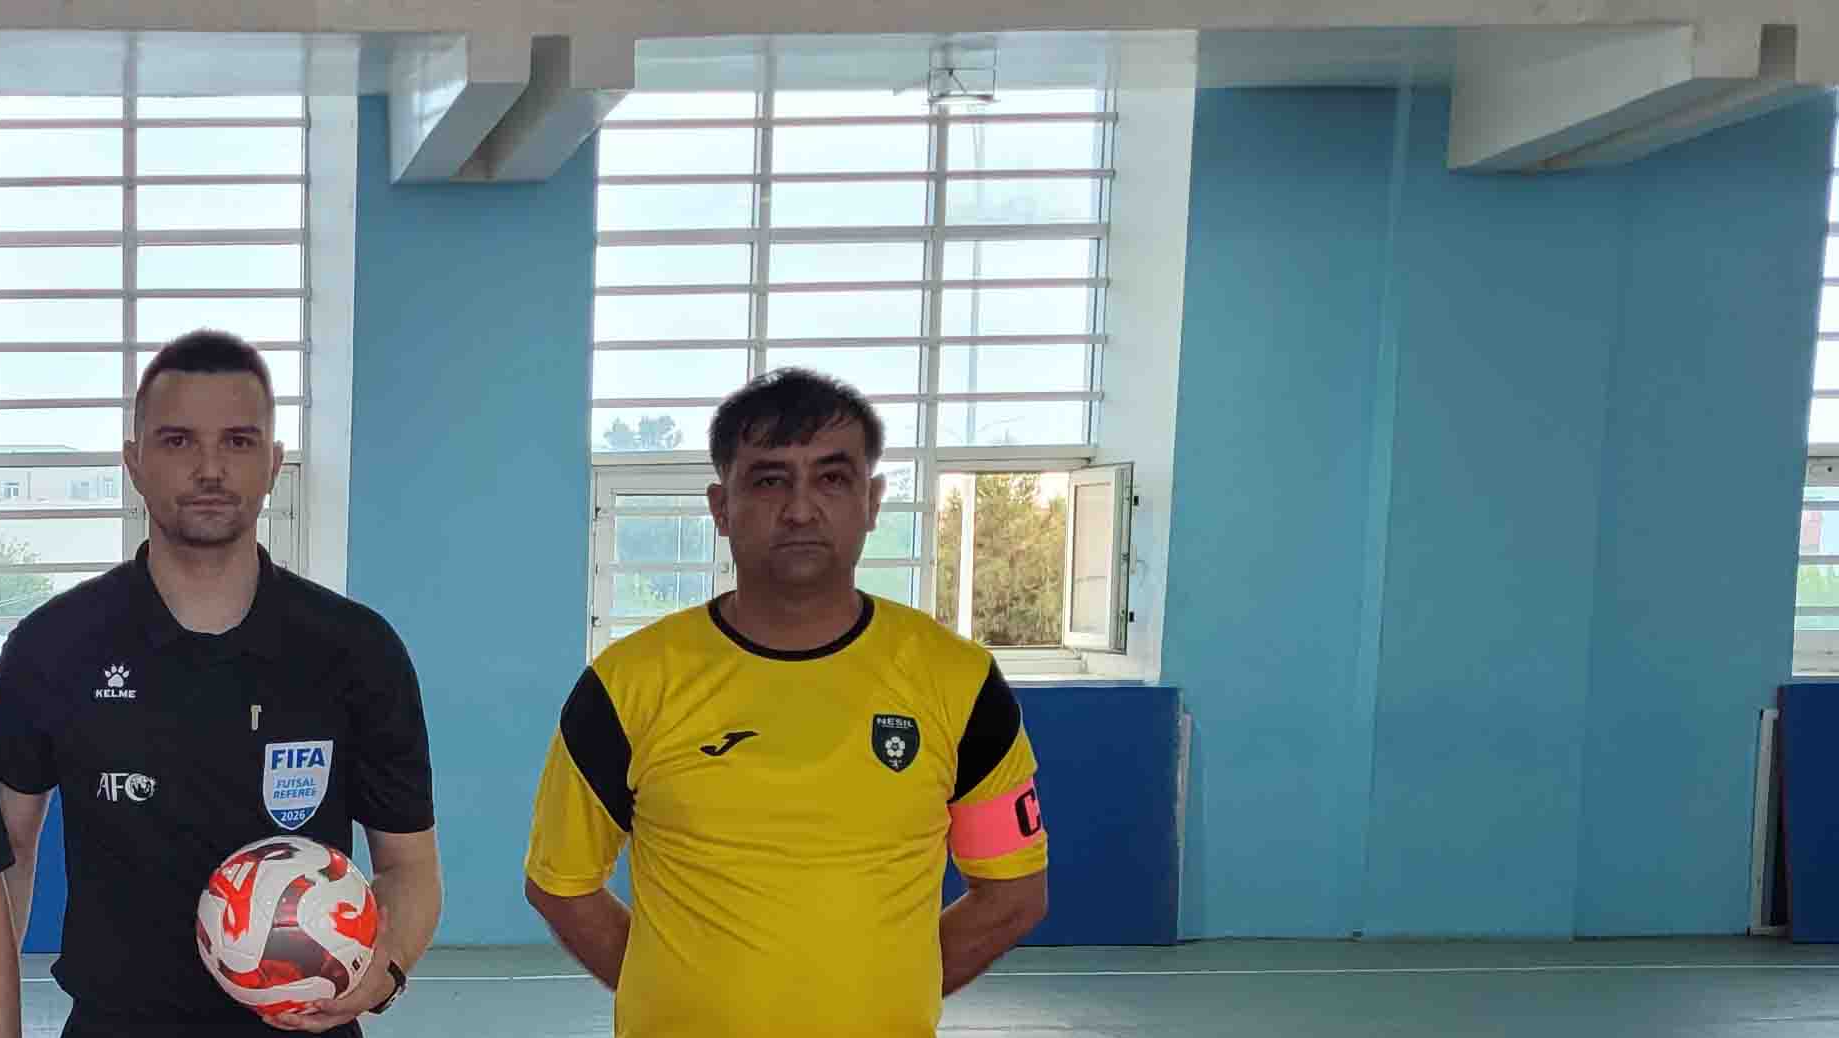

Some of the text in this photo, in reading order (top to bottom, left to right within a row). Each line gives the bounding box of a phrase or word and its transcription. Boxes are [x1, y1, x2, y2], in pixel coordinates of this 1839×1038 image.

[95, 688, 137, 698] KELME
[876, 717, 913, 728] NESIL
[272, 748, 325, 769] FIFA
[96, 772, 155, 802] AFC
[275, 777, 316, 789] FUTSAL
[273, 786, 317, 800] REFEREE
